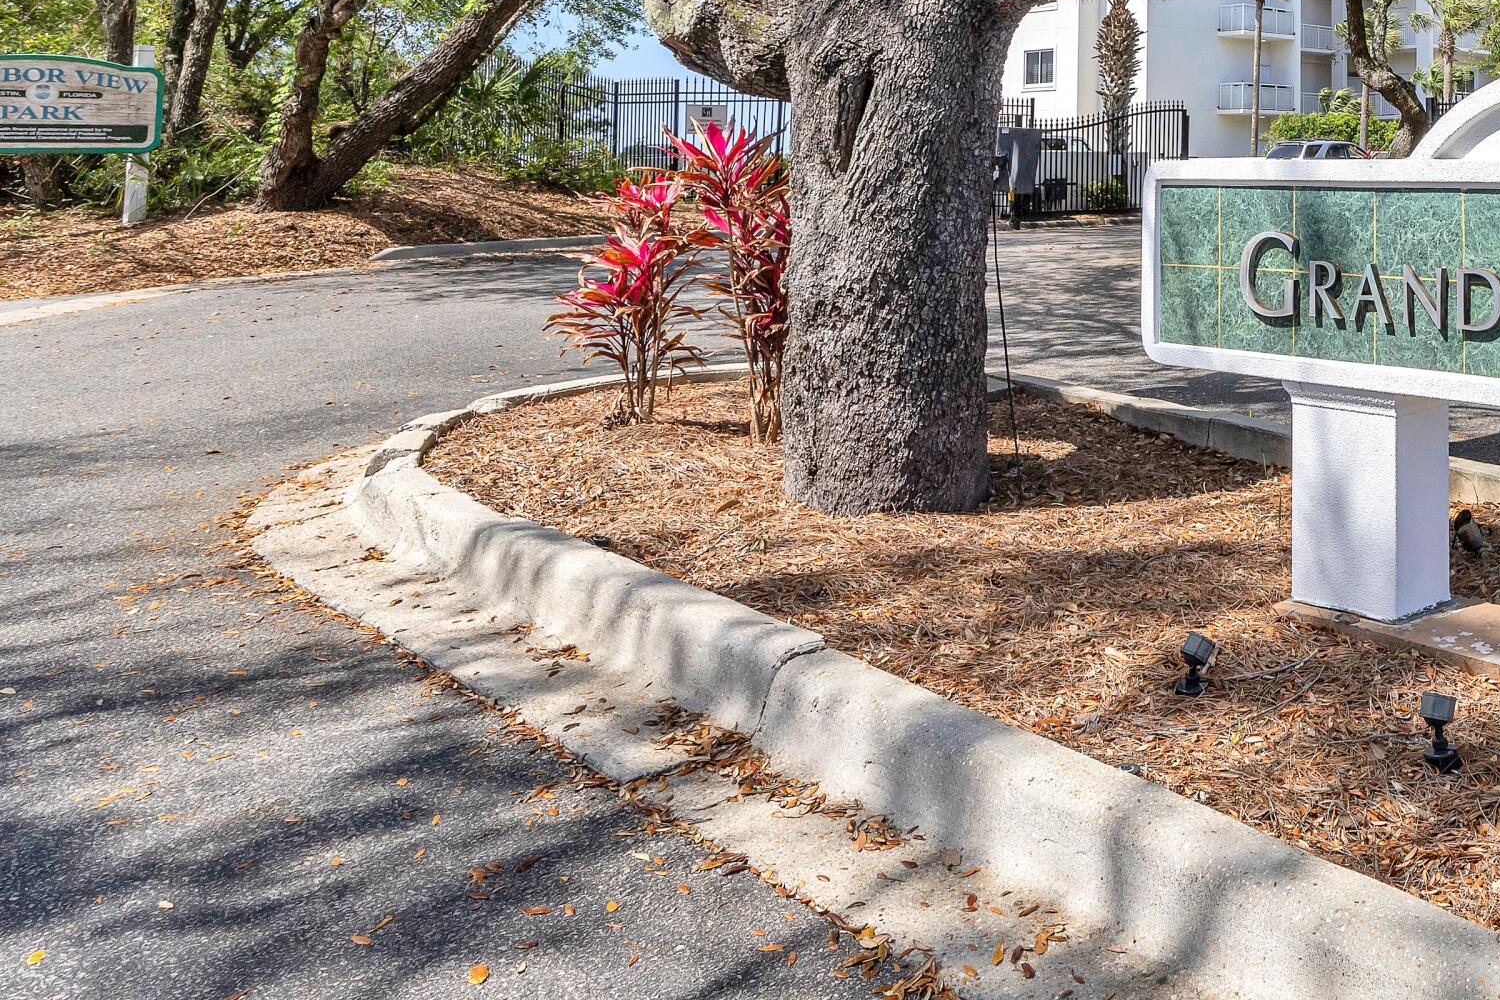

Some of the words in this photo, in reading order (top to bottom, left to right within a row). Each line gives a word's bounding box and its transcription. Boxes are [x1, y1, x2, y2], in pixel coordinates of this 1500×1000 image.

[1, 67, 66, 83] BOR
[74, 69, 149, 94] VIEW
[0, 104, 83, 120] PARK
